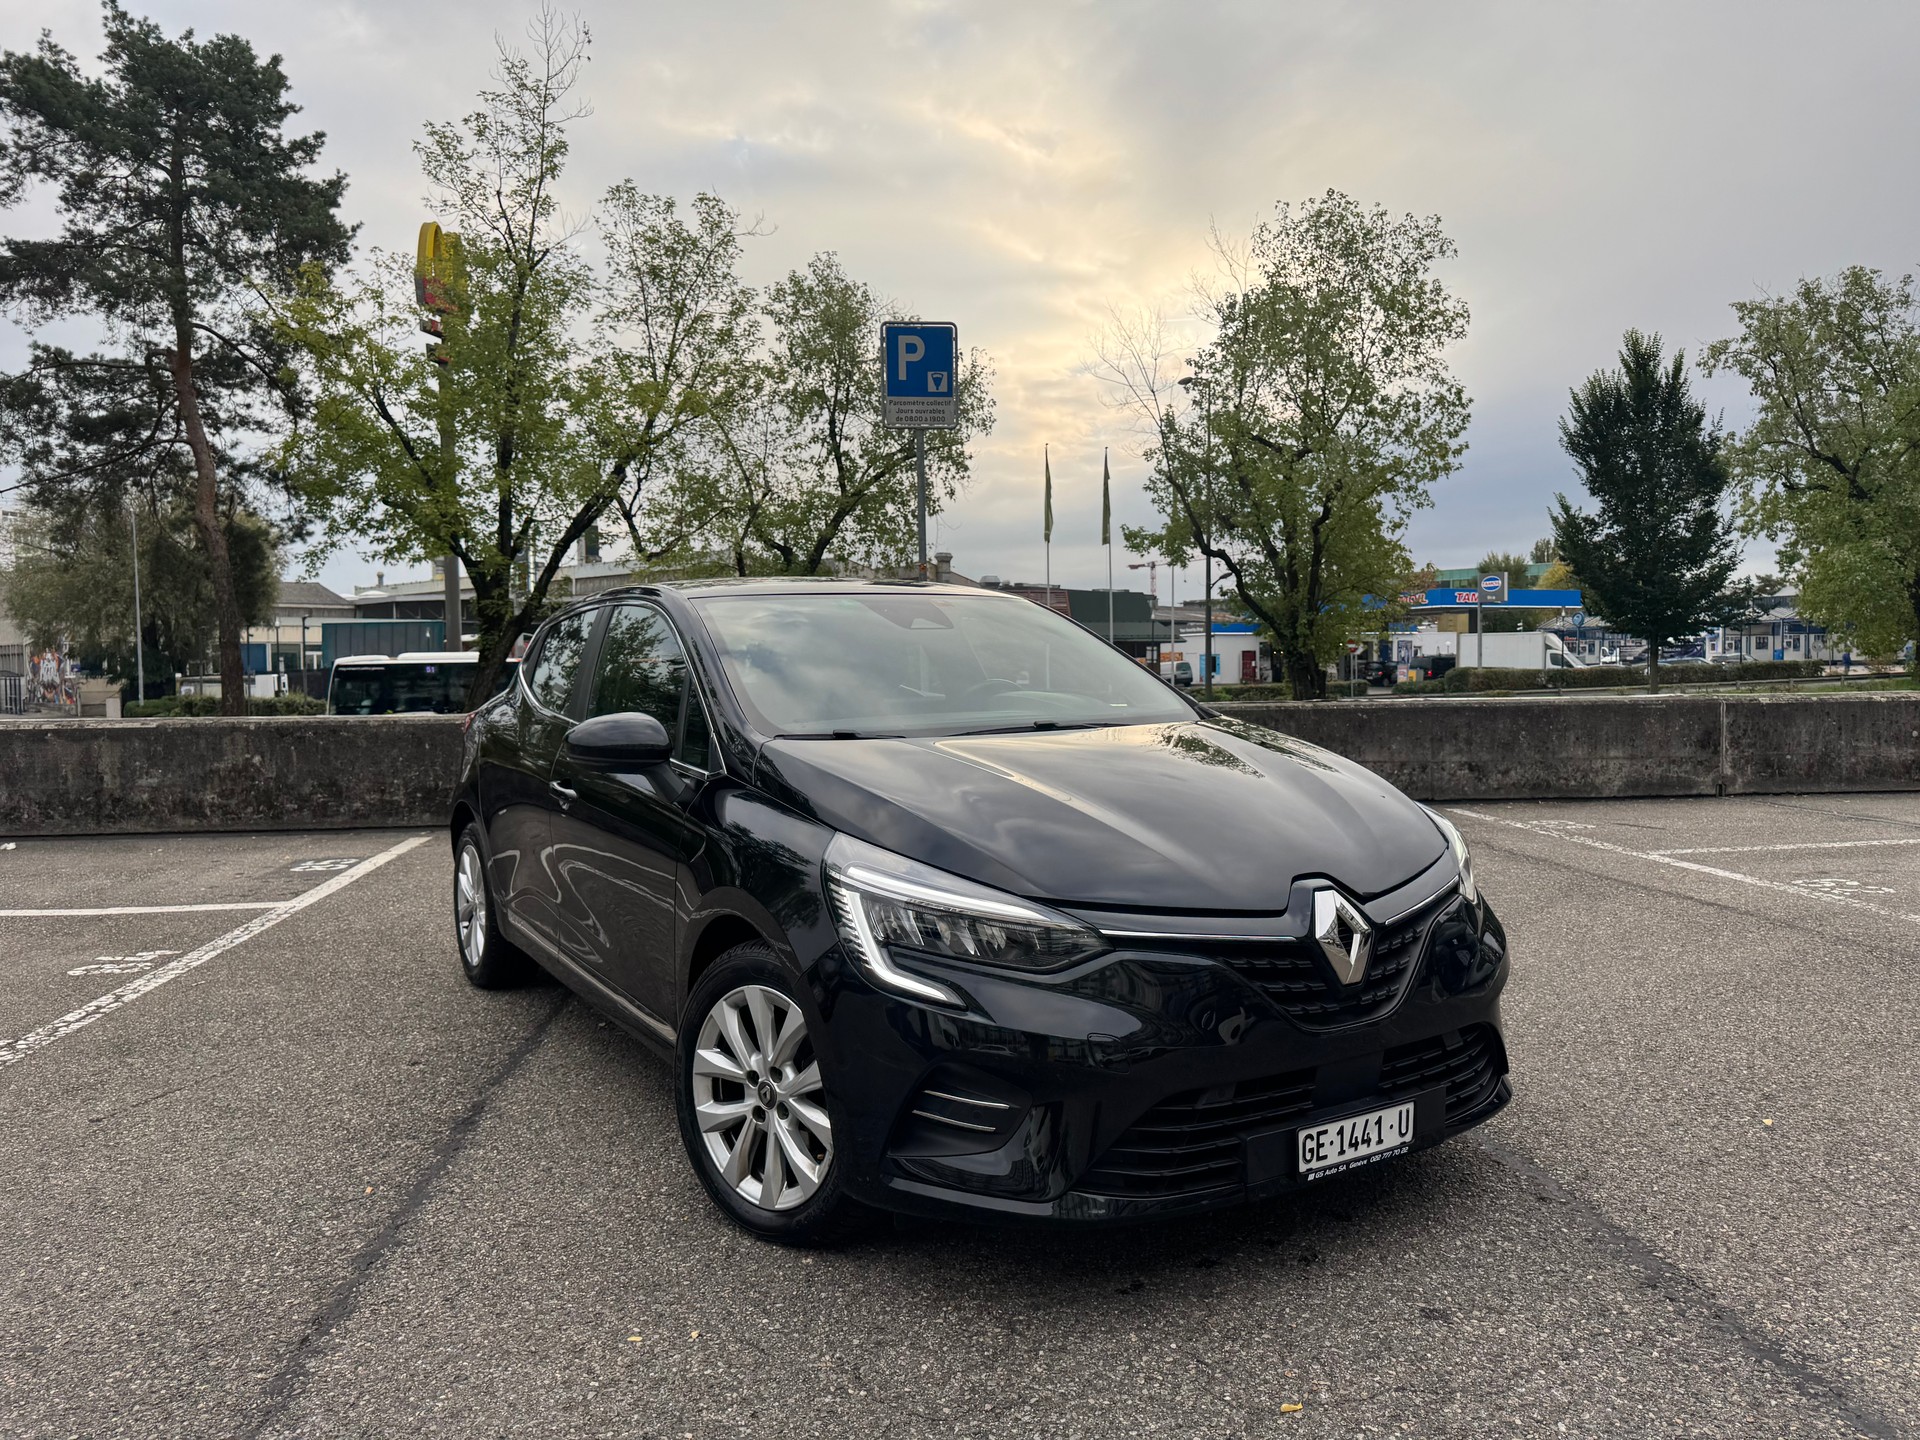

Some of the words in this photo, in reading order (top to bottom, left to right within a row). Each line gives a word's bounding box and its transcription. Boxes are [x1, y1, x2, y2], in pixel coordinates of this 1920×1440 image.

[897, 335, 926, 381] P
[1455, 592, 1478, 604] TAM
[1324, 1167, 1338, 1176] Auto
[1338, 1164, 1347, 1172] SA
[1369, 1154, 1382, 1163] 022
[1381, 1150, 1393, 1160] 777
[1392, 1148, 1401, 1157] 70
[1400, 1146, 1410, 1154] 22
